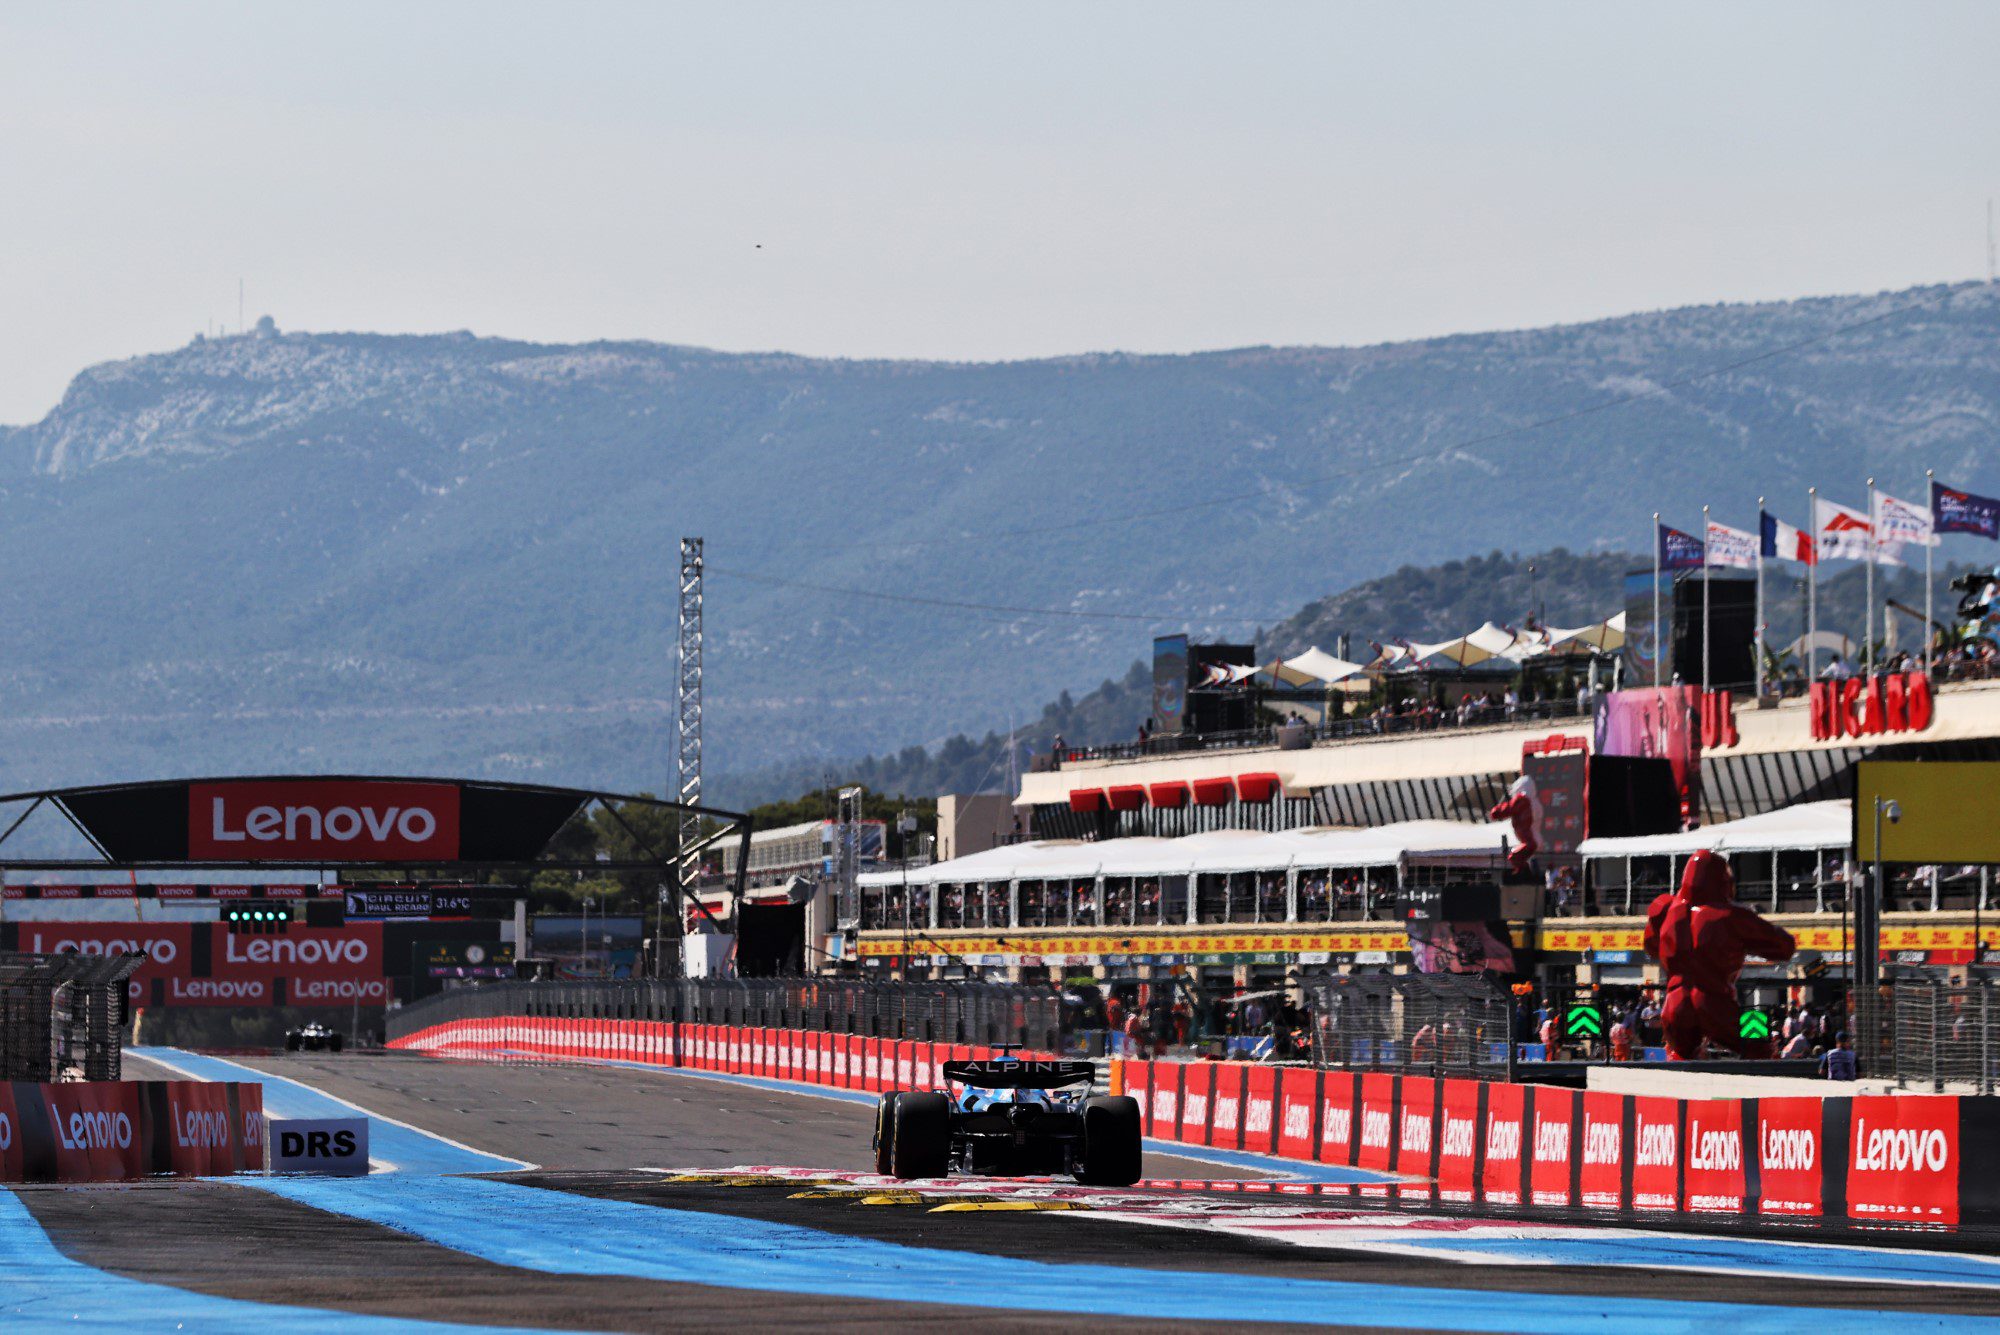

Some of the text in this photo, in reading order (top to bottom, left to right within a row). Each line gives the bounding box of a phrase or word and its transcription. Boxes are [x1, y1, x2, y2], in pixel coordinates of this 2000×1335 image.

[1810, 671, 1931, 741] RICARD
[214, 797, 436, 842] Lenovo
[97, 886, 133, 896] Lenovo
[158, 885, 194, 896] Lenovo
[212, 885, 248, 896] Lenovo
[266, 885, 302, 896] Lenovo
[368, 895, 430, 903] CIRCUIT
[227, 932, 368, 964] Lenovo
[173, 978, 264, 998] Lenovo
[295, 978, 384, 998] Lenovo
[964, 1061, 1073, 1073] ALPINE
[52, 1103, 132, 1150] Lenovo
[174, 1102, 228, 1148] Lenovo
[1584, 1113, 1620, 1165] Lenovo
[1637, 1113, 1676, 1167] Lenovo
[281, 1130, 357, 1158] DRS
[1691, 1120, 1741, 1171] Lenovo
[1762, 1119, 1815, 1171] Lenovo
[1855, 1118, 1949, 1172] Lenovo
